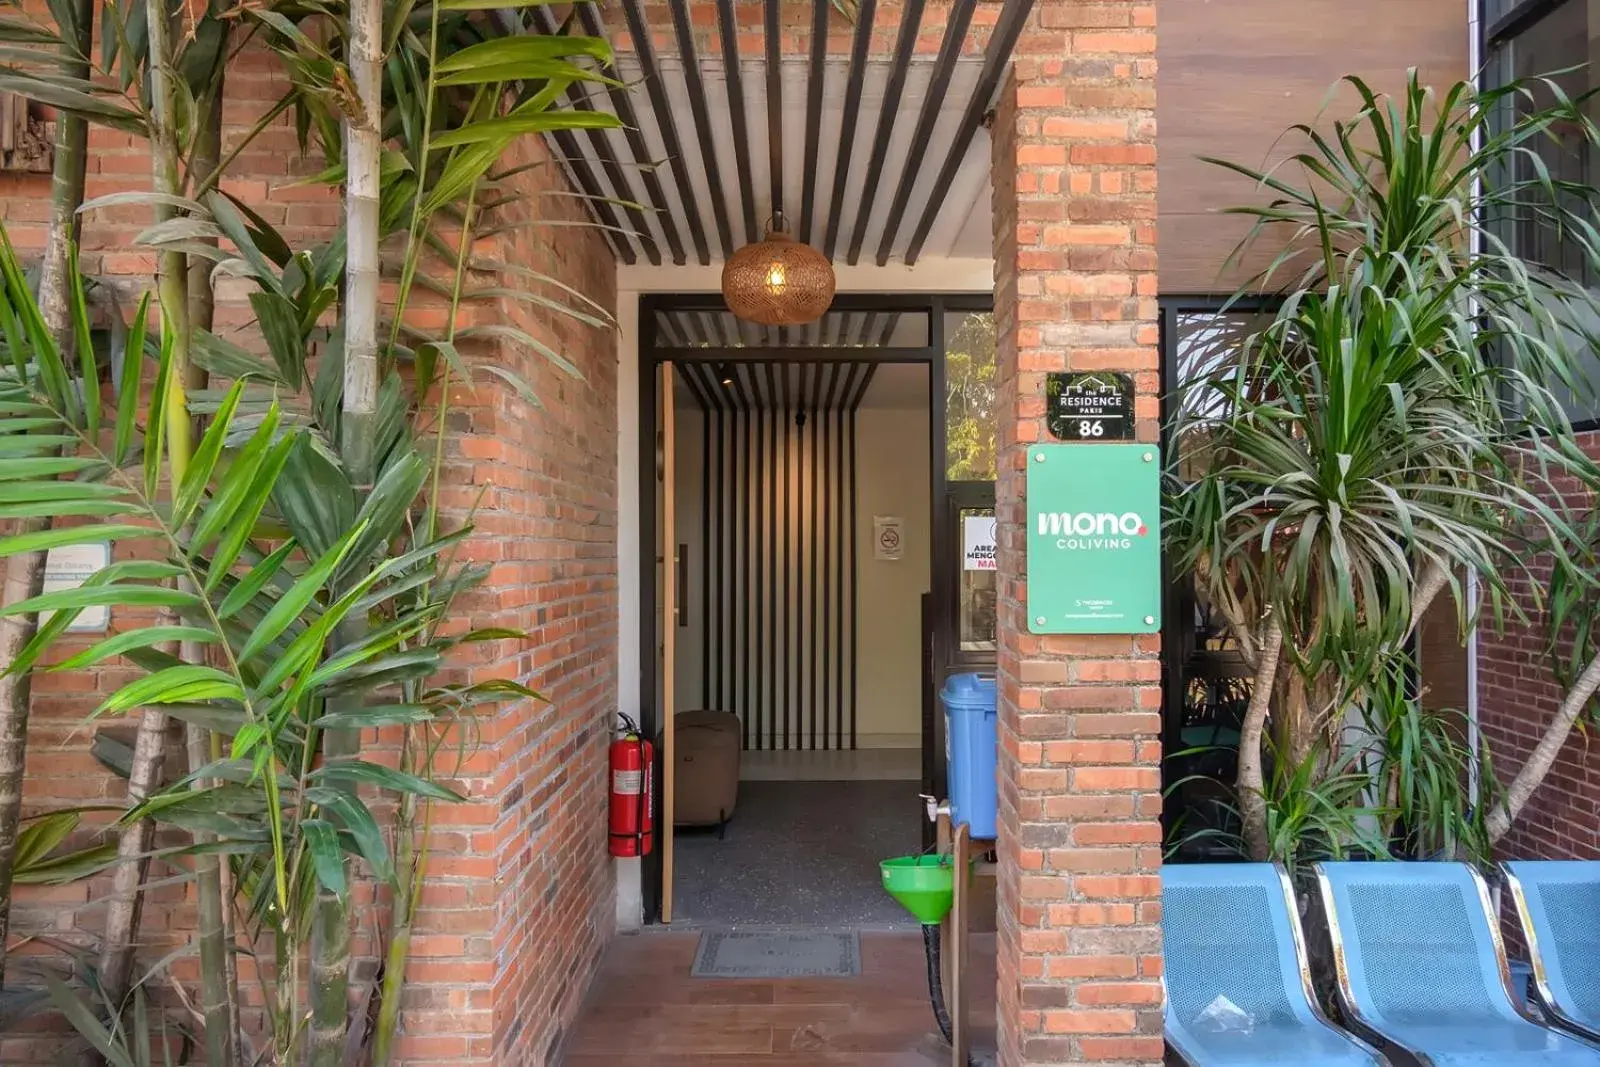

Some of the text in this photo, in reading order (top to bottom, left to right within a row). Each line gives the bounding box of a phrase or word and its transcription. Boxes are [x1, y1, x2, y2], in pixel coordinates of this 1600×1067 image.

[1060, 397, 1122, 406] RESIDENCE
[1079, 420, 1104, 437] 86
[1056, 538, 1132, 550] COLIVING
[977, 560, 998, 568] MA
